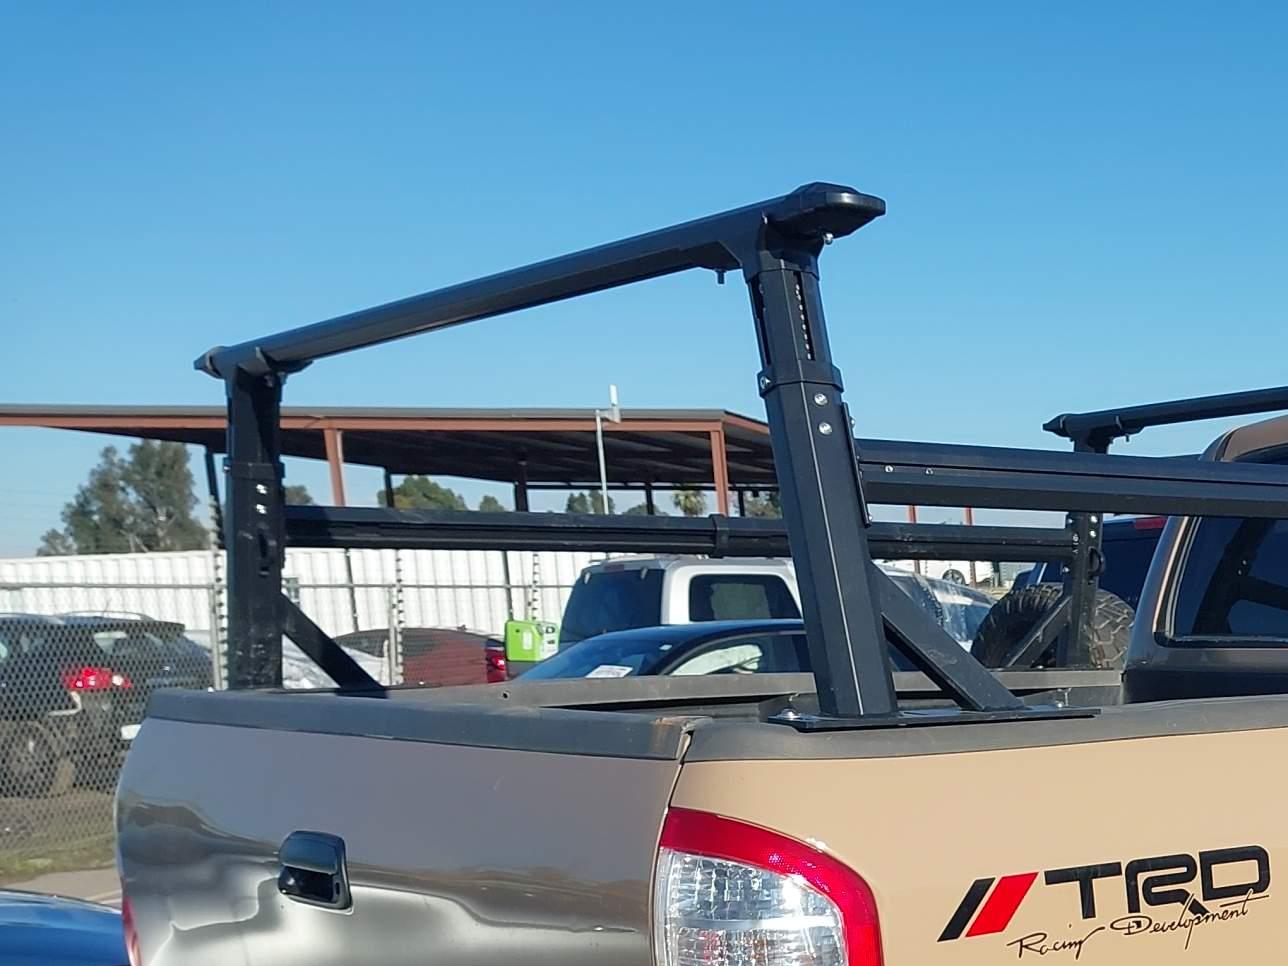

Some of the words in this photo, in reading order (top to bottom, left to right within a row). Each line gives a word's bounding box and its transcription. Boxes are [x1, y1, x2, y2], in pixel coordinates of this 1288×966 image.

[1044, 845, 1271, 920] TRD
[1006, 923, 1107, 961] Racing
[1110, 889, 1271, 951] Development
